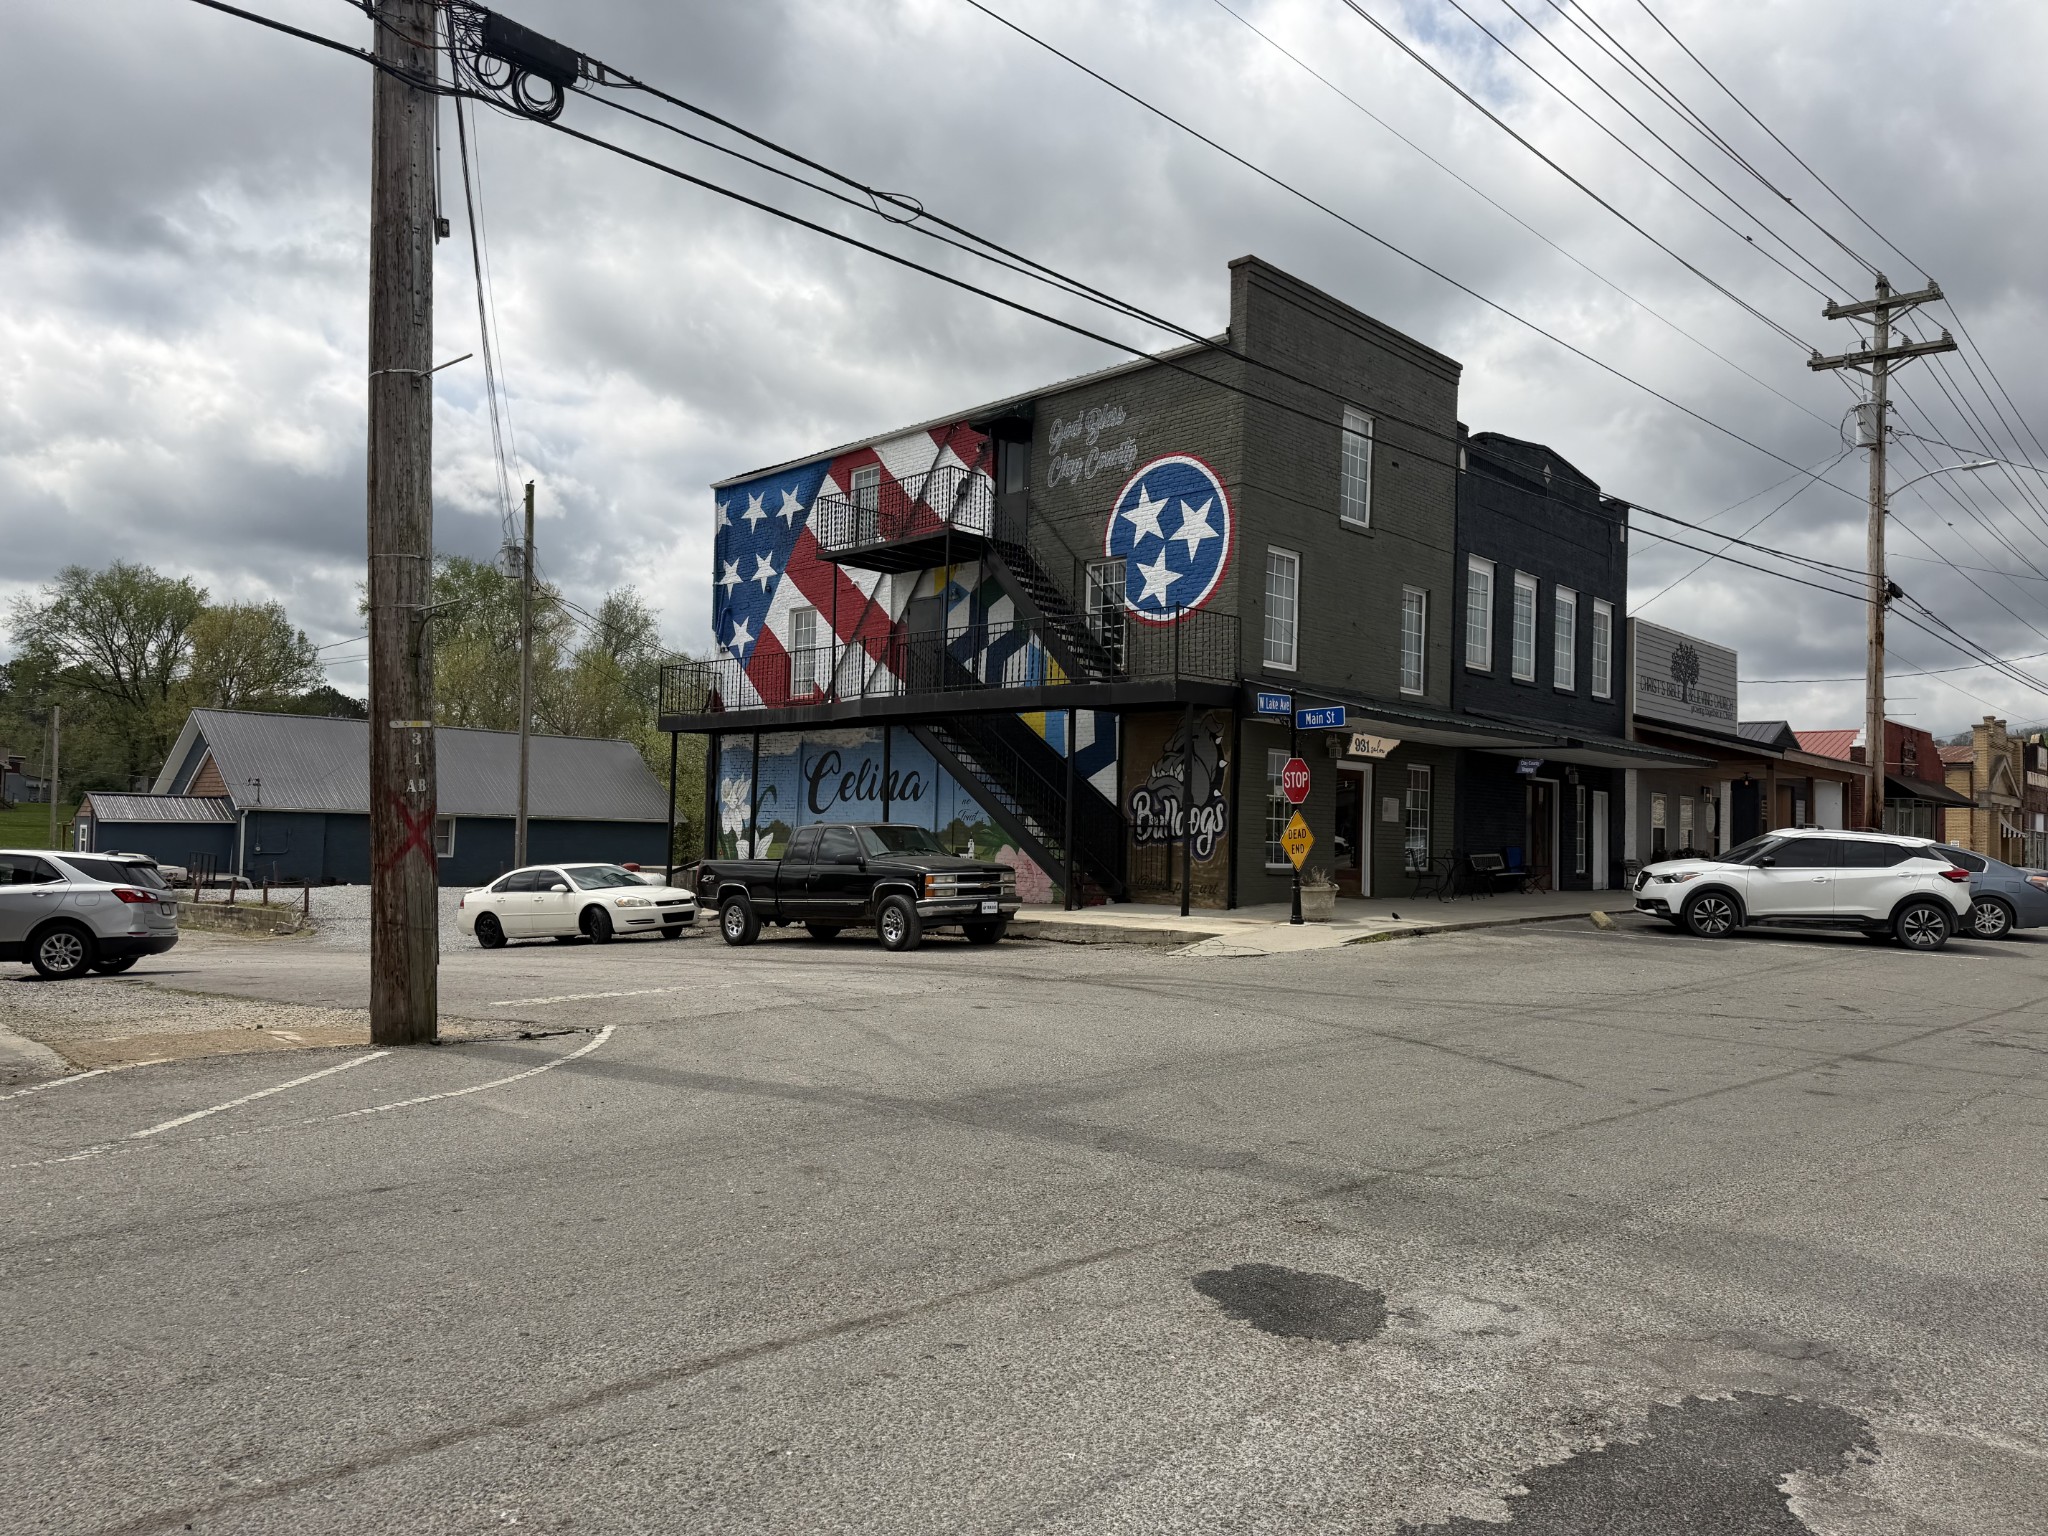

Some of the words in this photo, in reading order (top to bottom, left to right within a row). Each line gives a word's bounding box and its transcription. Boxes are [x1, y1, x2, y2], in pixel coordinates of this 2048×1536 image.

[1048, 452, 1084, 488] Clay
[1085, 436, 1138, 479] County
[1266, 697, 1279, 710] Lake
[1280, 698, 1290, 711] Ave
[1305, 712, 1324, 725] Main
[1326, 711, 1335, 724] St
[412, 732, 422, 745] 3
[1354, 737, 1370, 753] 931
[413, 752, 421, 765] 1
[804, 750, 930, 814] Celina
[1284, 771, 1308, 789] STOP
[1288, 828, 1307, 840] DEAD
[1291, 844, 1305, 855] END
